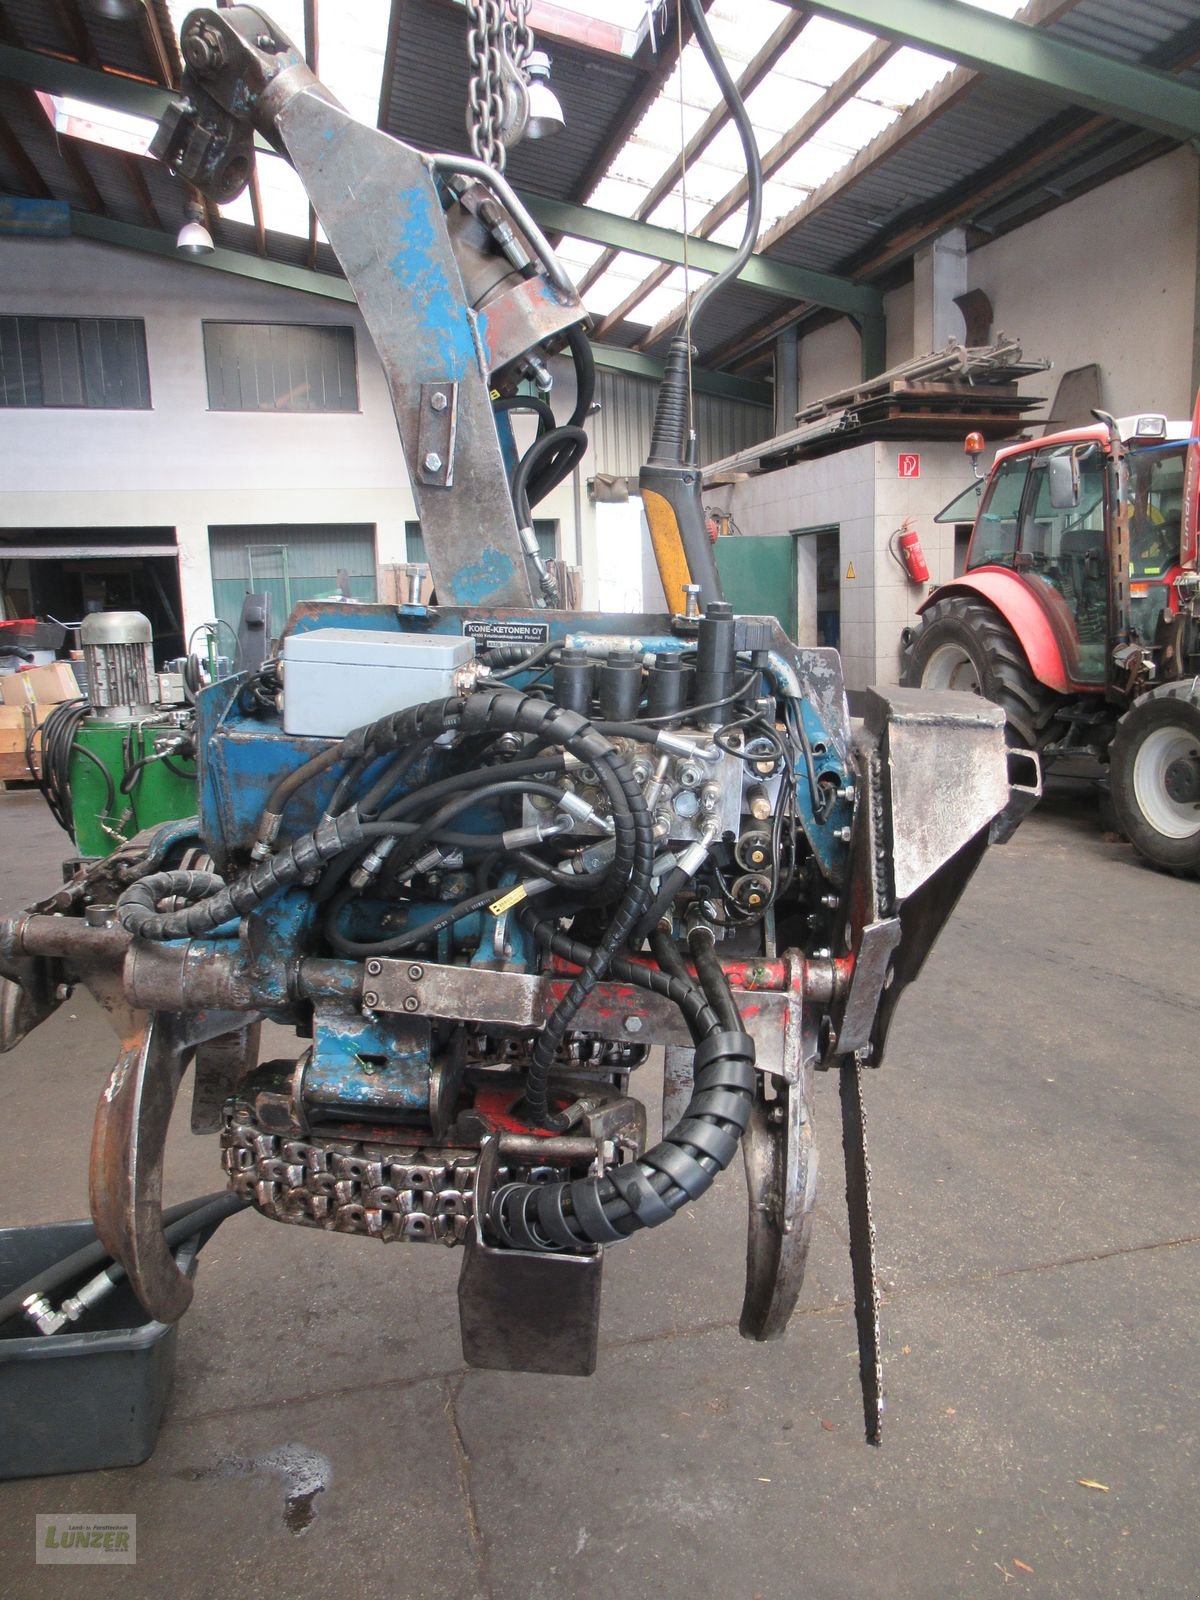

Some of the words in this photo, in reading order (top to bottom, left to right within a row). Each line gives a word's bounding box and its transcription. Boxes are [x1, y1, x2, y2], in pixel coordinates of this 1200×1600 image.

[1183, 457, 1193, 550] Lindner
[468, 625, 530, 634] KONE-KETONEN
[531, 627, 544, 635] OY
